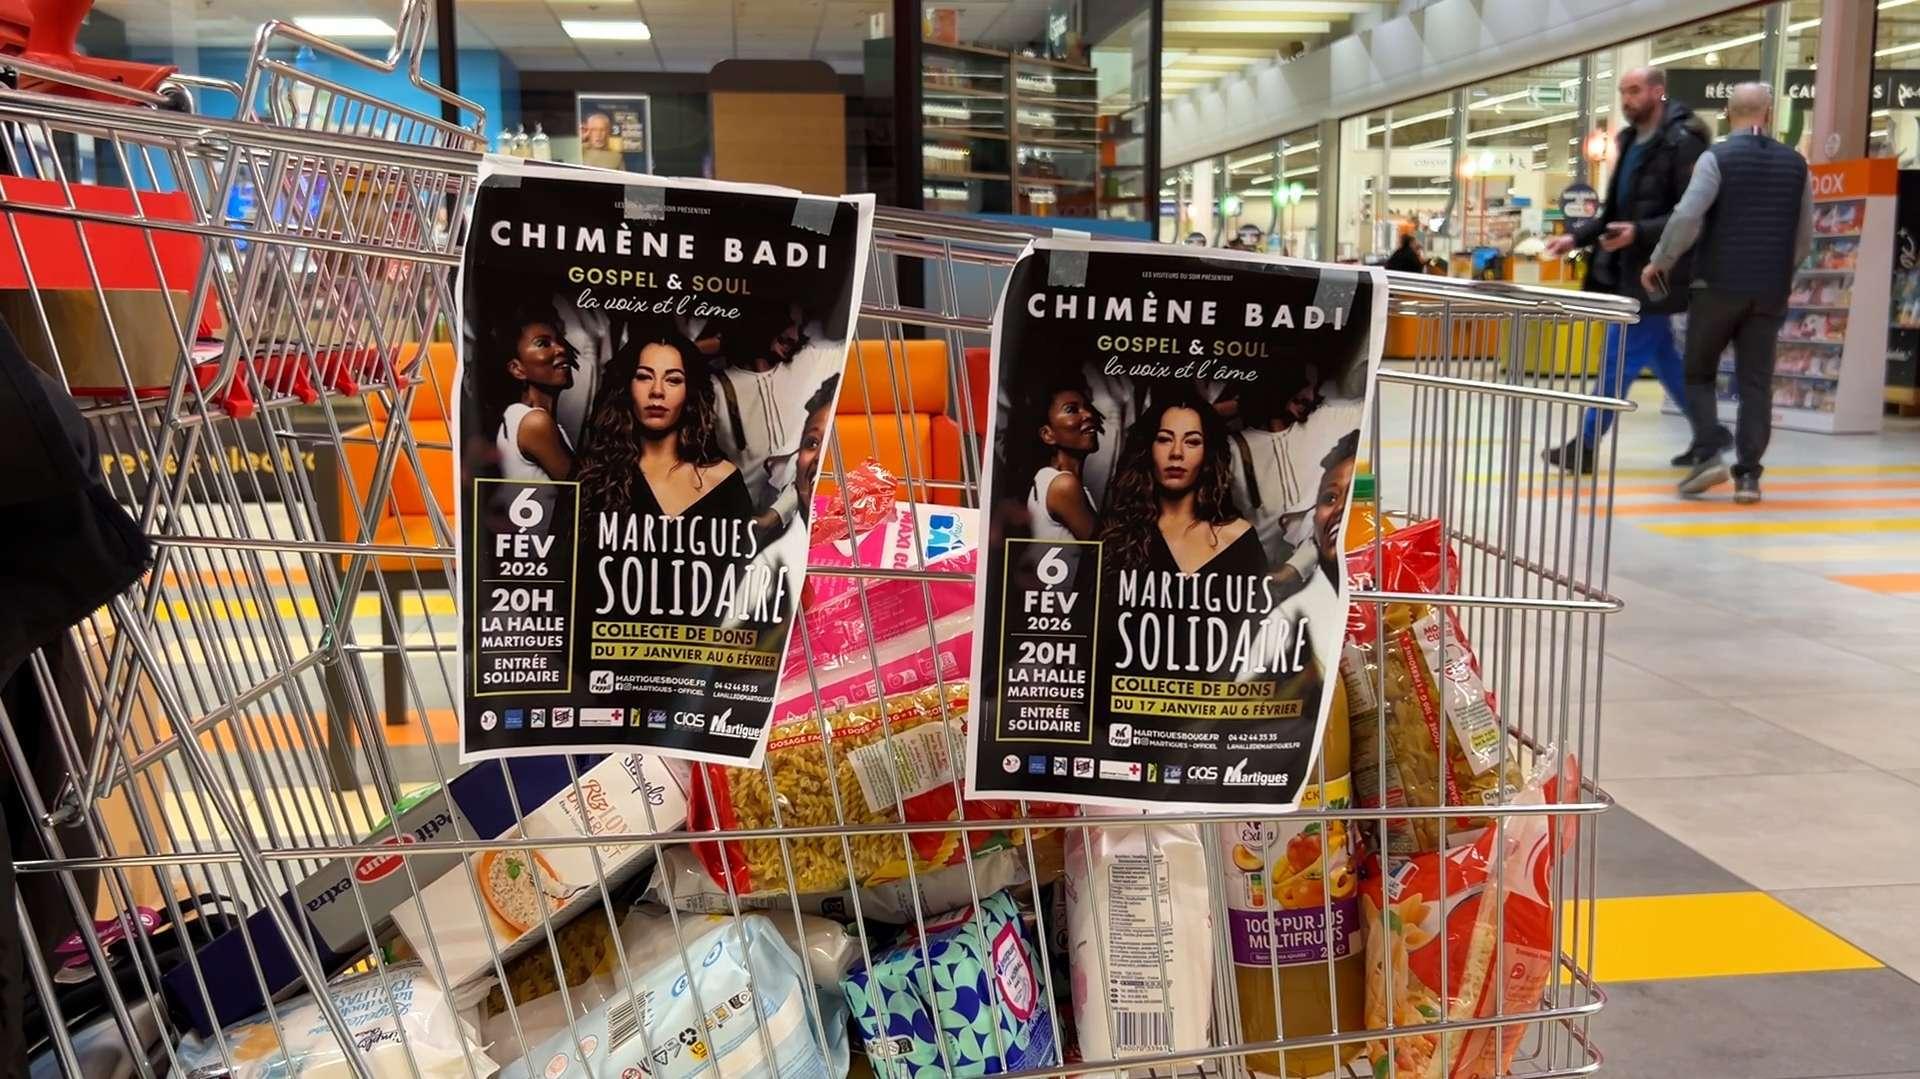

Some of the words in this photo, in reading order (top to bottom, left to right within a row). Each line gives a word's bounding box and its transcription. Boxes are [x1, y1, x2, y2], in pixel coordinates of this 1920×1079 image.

[490, 220, 696, 260] CHIMÈNE
[723, 238, 828, 270] BADI
[568, 267, 658, 288] GOSPEL
[666, 274, 684, 290] &
[692, 276, 752, 296] SOUL
[576, 288, 601, 309] la
[604, 294, 649, 313] voix
[653, 298, 674, 315] et
[1027, 291, 1217, 326] CHIMÈNE
[1244, 305, 1343, 330] BADI
[1097, 336, 1180, 354] GOSPEL
[1188, 340, 1204, 356] &
[1213, 340, 1270, 358] SOUL
[1104, 356, 1125, 376] la
[1129, 362, 1171, 378] voix
[1174, 362, 1194, 378] et
[508, 488, 544, 527] 6
[495, 526, 556, 559] FÉV
[598, 511, 759, 560] MARTIGUES
[500, 562, 548, 578] 2026
[1036, 547, 1069, 585] 6
[491, 588, 554, 613] 20H
[595, 555, 789, 624] SOLIDAIRE
[1024, 584, 1080, 615] FÉV
[1118, 569, 1274, 615] MARTIGUES
[481, 616, 504, 632] LA
[506, 616, 564, 632] HALLE
[595, 622, 680, 642] COLLECTE
[686, 627, 708, 642] DE
[712, 628, 754, 646] DONS
[1027, 616, 1072, 632] 2026
[481, 634, 564, 648] MARTIGUES
[1115, 611, 1309, 674] SOLIDAIRE
[494, 654, 548, 671] ENTRÉE
[595, 645, 616, 657] DU
[621, 646, 638, 658] 17
[642, 646, 702, 662] JANVIER
[706, 651, 724, 664] AU
[726, 652, 734, 664] 6
[737, 651, 776, 668] FÉVRIER
[1018, 641, 1076, 665] 20H
[483, 670, 560, 685] SOLIDAIRE
[616, 675, 707, 687] MARTIGUESBOUGE.FR
[1008, 668, 1030, 683] LA
[1033, 669, 1086, 684] HALLE
[1115, 677, 1194, 695] COLLECTE
[1201, 682, 1222, 696] DE
[1226, 682, 1272, 697] DONS
[1008, 685, 1085, 699] MARTIGUES
[1020, 703, 1070, 720] ENTRÉE
[1114, 698, 1134, 711] DU
[1138, 700, 1155, 712] 17
[1160, 700, 1218, 716] JANVIER
[1220, 703, 1238, 716] AU
[1241, 703, 1250, 716] 6
[1252, 700, 1298, 716] FÉVRIER
[1008, 719, 1081, 733] SOLIDAIRE
[1133, 728, 1220, 742] MARTIGUESBOUGE.FR
[1150, 741, 1188, 749] MARTIGUES
[1223, 758, 1288, 786] Martigues
[581, 779, 609, 811] Riz
[1242, 830, 1274, 842] Exta
[306, 877, 352, 912] extra
[1283, 916, 1315, 932] PUR
